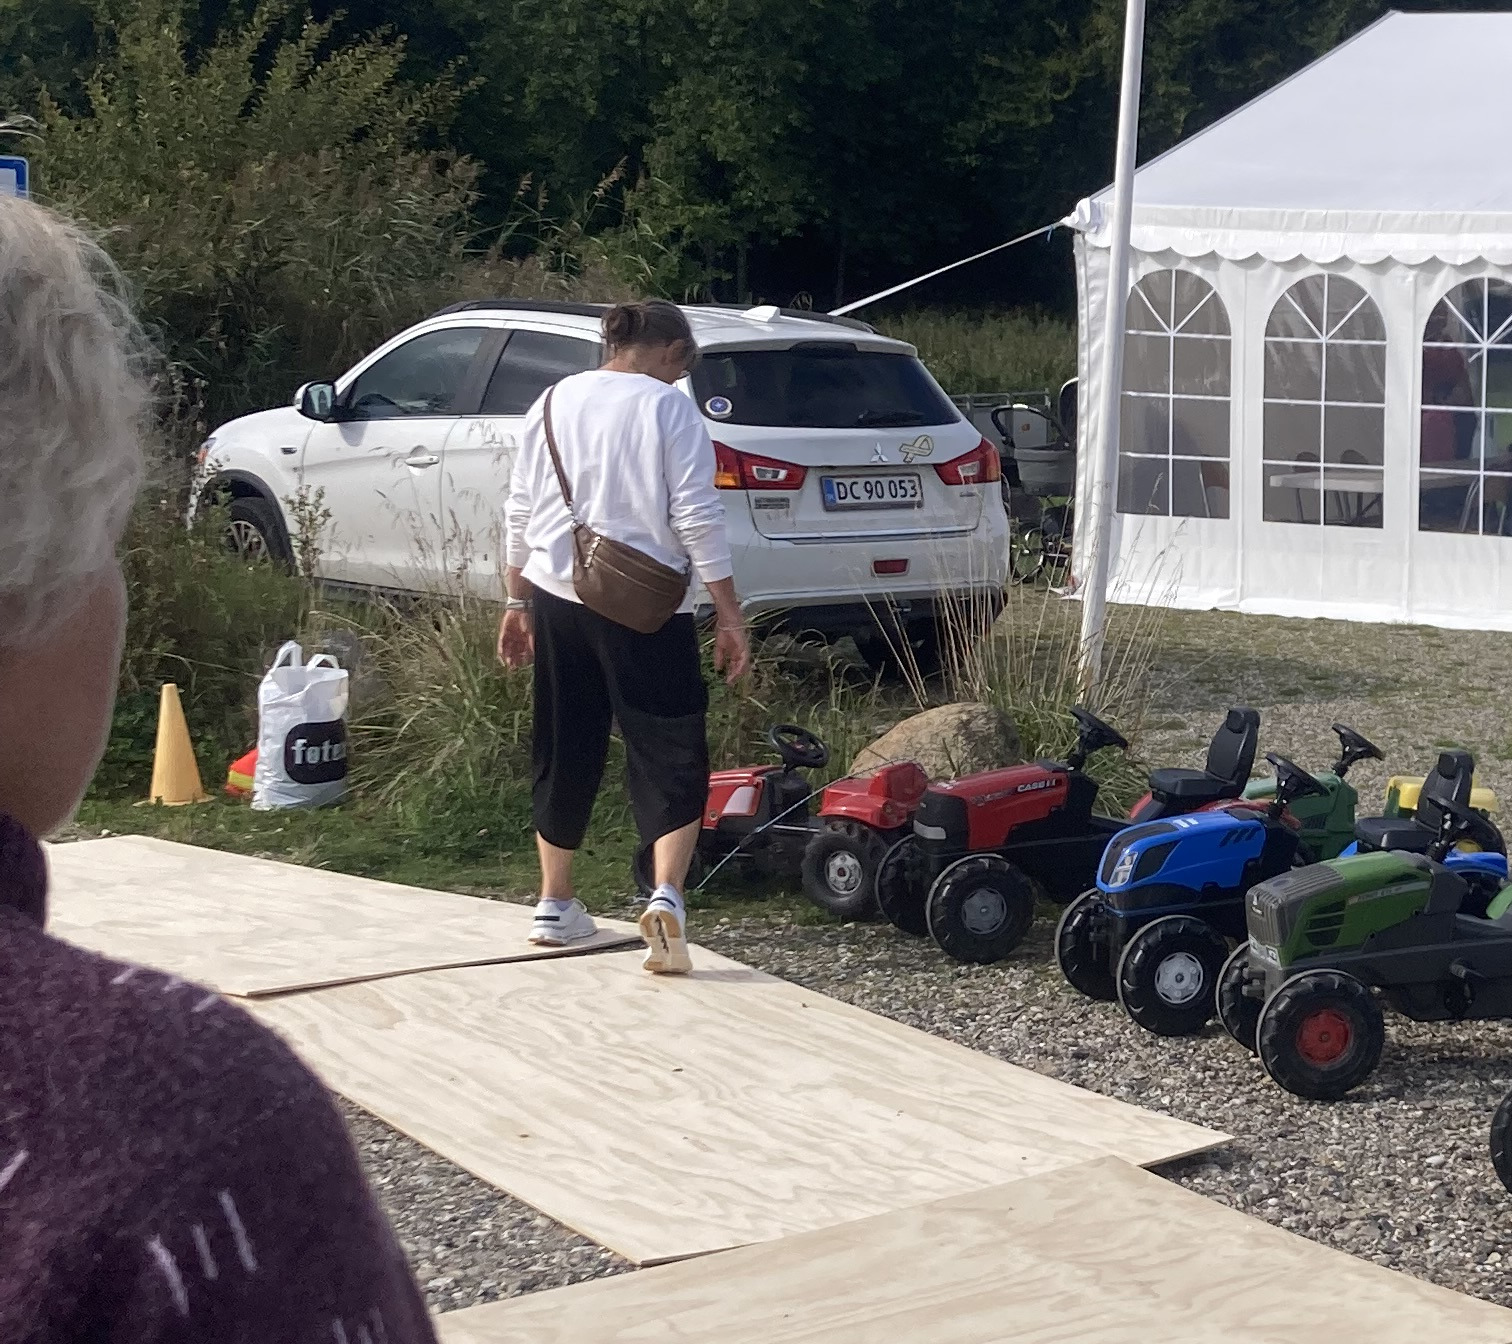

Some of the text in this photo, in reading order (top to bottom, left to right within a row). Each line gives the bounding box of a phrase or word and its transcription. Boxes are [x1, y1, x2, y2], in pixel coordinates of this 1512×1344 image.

[836, 481, 861, 501] DC
[864, 480, 885, 500] 90
[889, 479, 918, 499] 053
[1017, 781, 1046, 793] CASE
